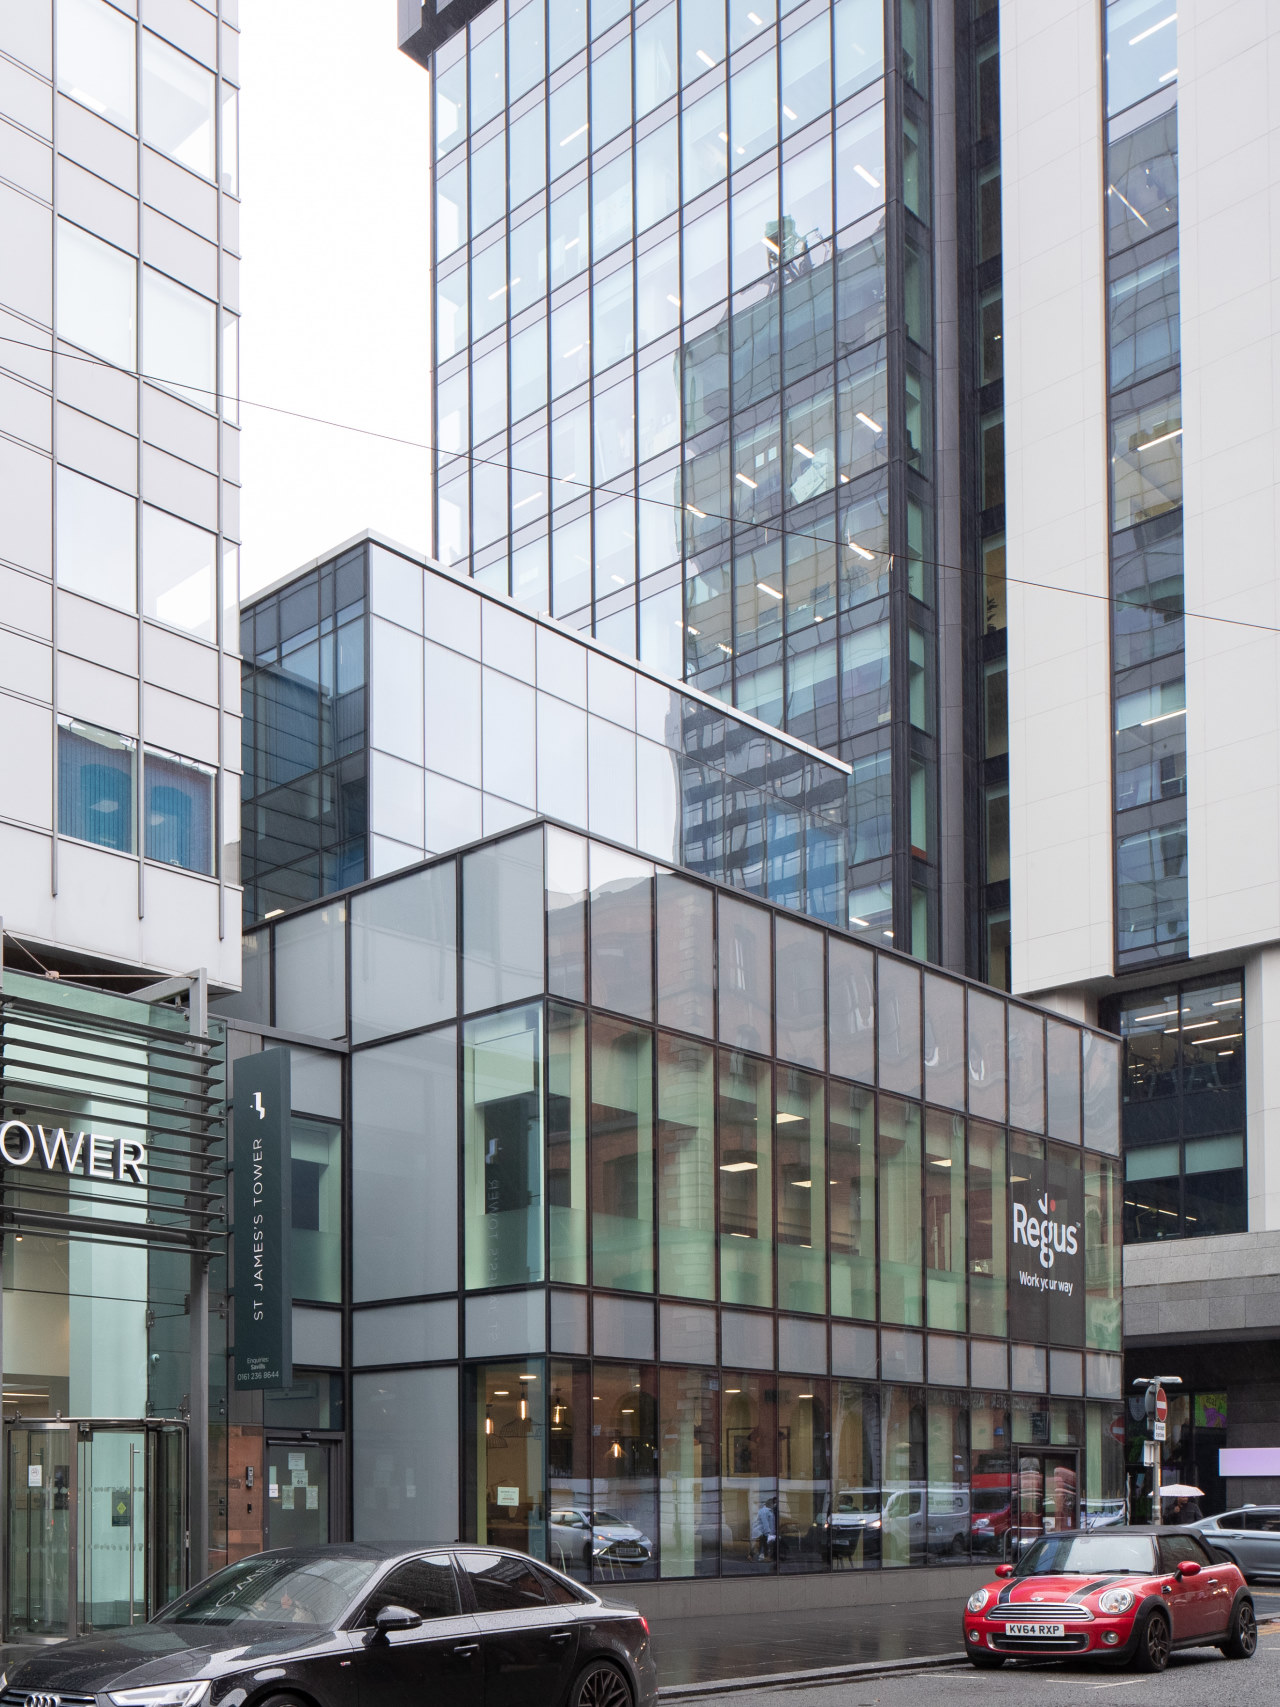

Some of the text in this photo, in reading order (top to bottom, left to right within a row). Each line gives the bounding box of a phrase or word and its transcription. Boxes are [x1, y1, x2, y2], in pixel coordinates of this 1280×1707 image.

[252, 1138, 263, 1207] TOWER
[1013, 1202, 1078, 1269] Regus
[1019, 1270, 1040, 1287] Work
[1058, 1281, 1073, 1296] way
[253, 1299, 264, 1321] ST
[237, 1373, 250, 1381] 0161
[1009, 1624, 1060, 1635] KV64 RXP
